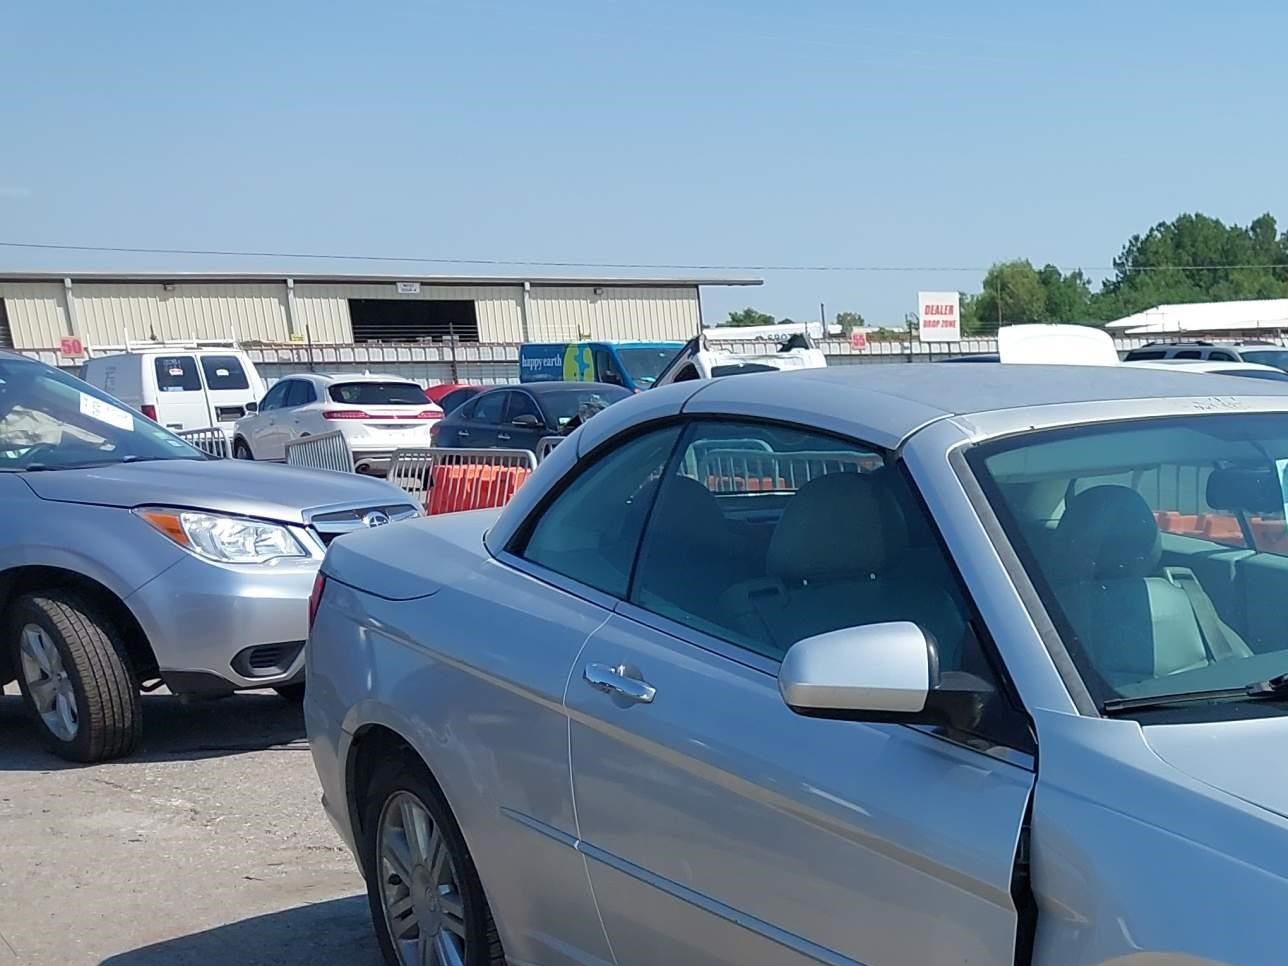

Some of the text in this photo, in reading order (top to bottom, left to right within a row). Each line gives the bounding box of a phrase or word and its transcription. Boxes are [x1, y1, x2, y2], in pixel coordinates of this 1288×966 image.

[924, 304, 954, 315] DEALER
[923, 320, 956, 328] DROP ZONE
[61, 339, 82, 354] 50
[522, 353, 562, 371] happy earth
